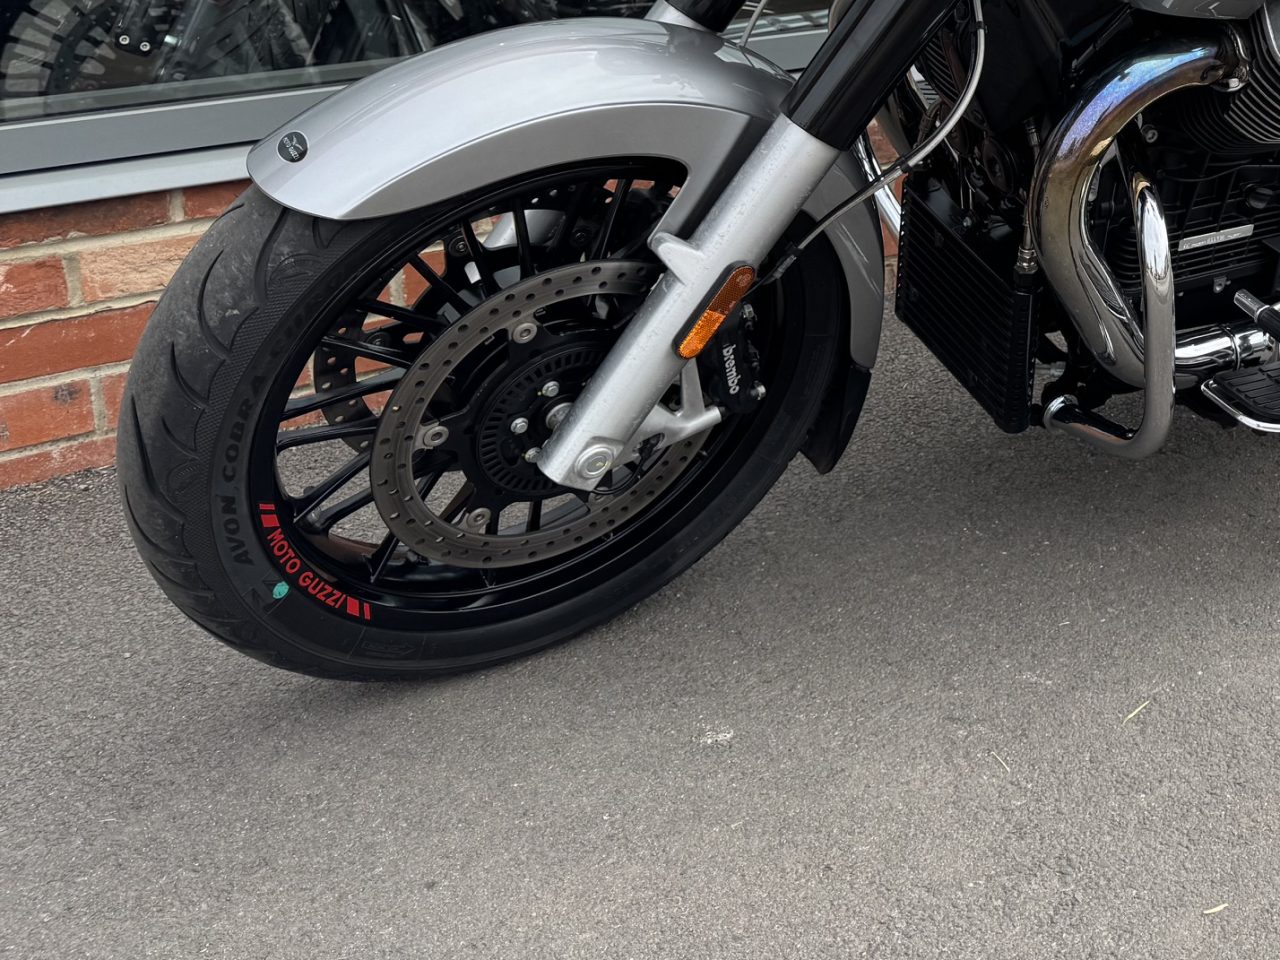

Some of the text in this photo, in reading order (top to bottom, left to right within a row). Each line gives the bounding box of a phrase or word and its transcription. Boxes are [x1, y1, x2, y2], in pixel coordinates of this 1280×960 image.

[723, 343, 741, 395] brembo
[221, 375, 267, 566] AVON COBRA
[267, 528, 346, 609] MOTO GUZZI
